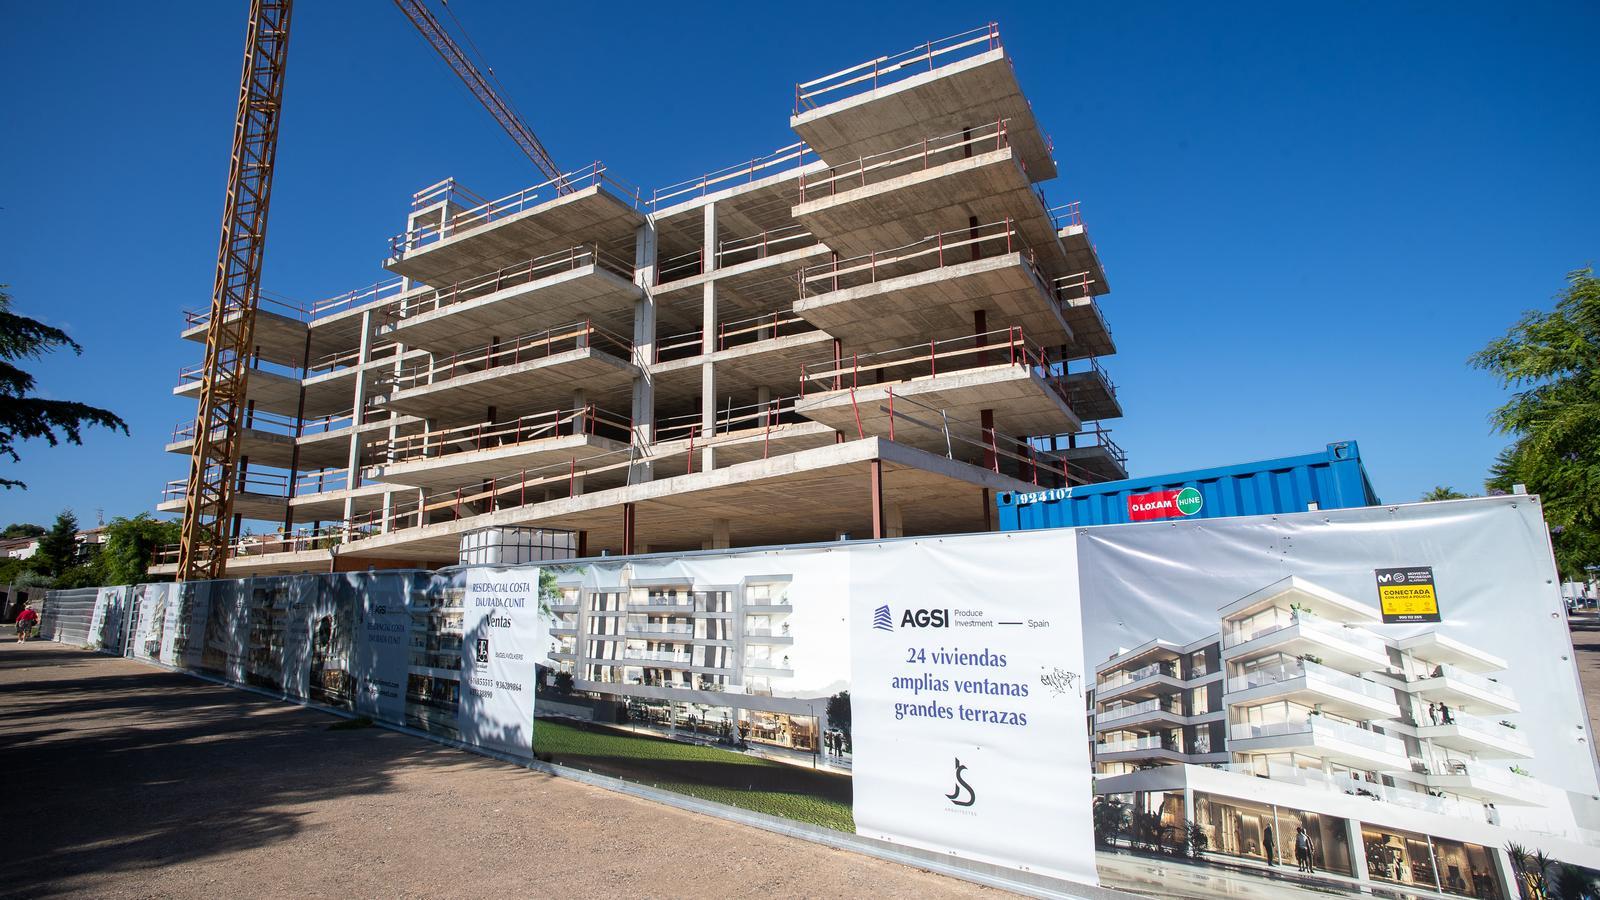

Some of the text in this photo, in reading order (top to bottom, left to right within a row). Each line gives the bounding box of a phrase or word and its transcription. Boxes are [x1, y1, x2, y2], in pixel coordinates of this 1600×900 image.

[1019, 487, 1073, 505] 924107
[1178, 496, 1200, 506] HUNE
[1139, 500, 1172, 511] LOXAM
[509, 582, 530, 593] COSTA
[503, 598, 525, 608] CUNIT
[900, 608, 949, 628] AGSI
[954, 609, 983, 617] Produce
[486, 614, 512, 628] Ventas
[954, 619, 993, 628] Investment
[1027, 619, 1050, 629] Spain
[906, 647, 1007, 668] 24 viviendas
[891, 673, 949, 695] amplias
[954, 678, 1029, 697] ventanas
[894, 700, 1027, 726] grandes terrazas
